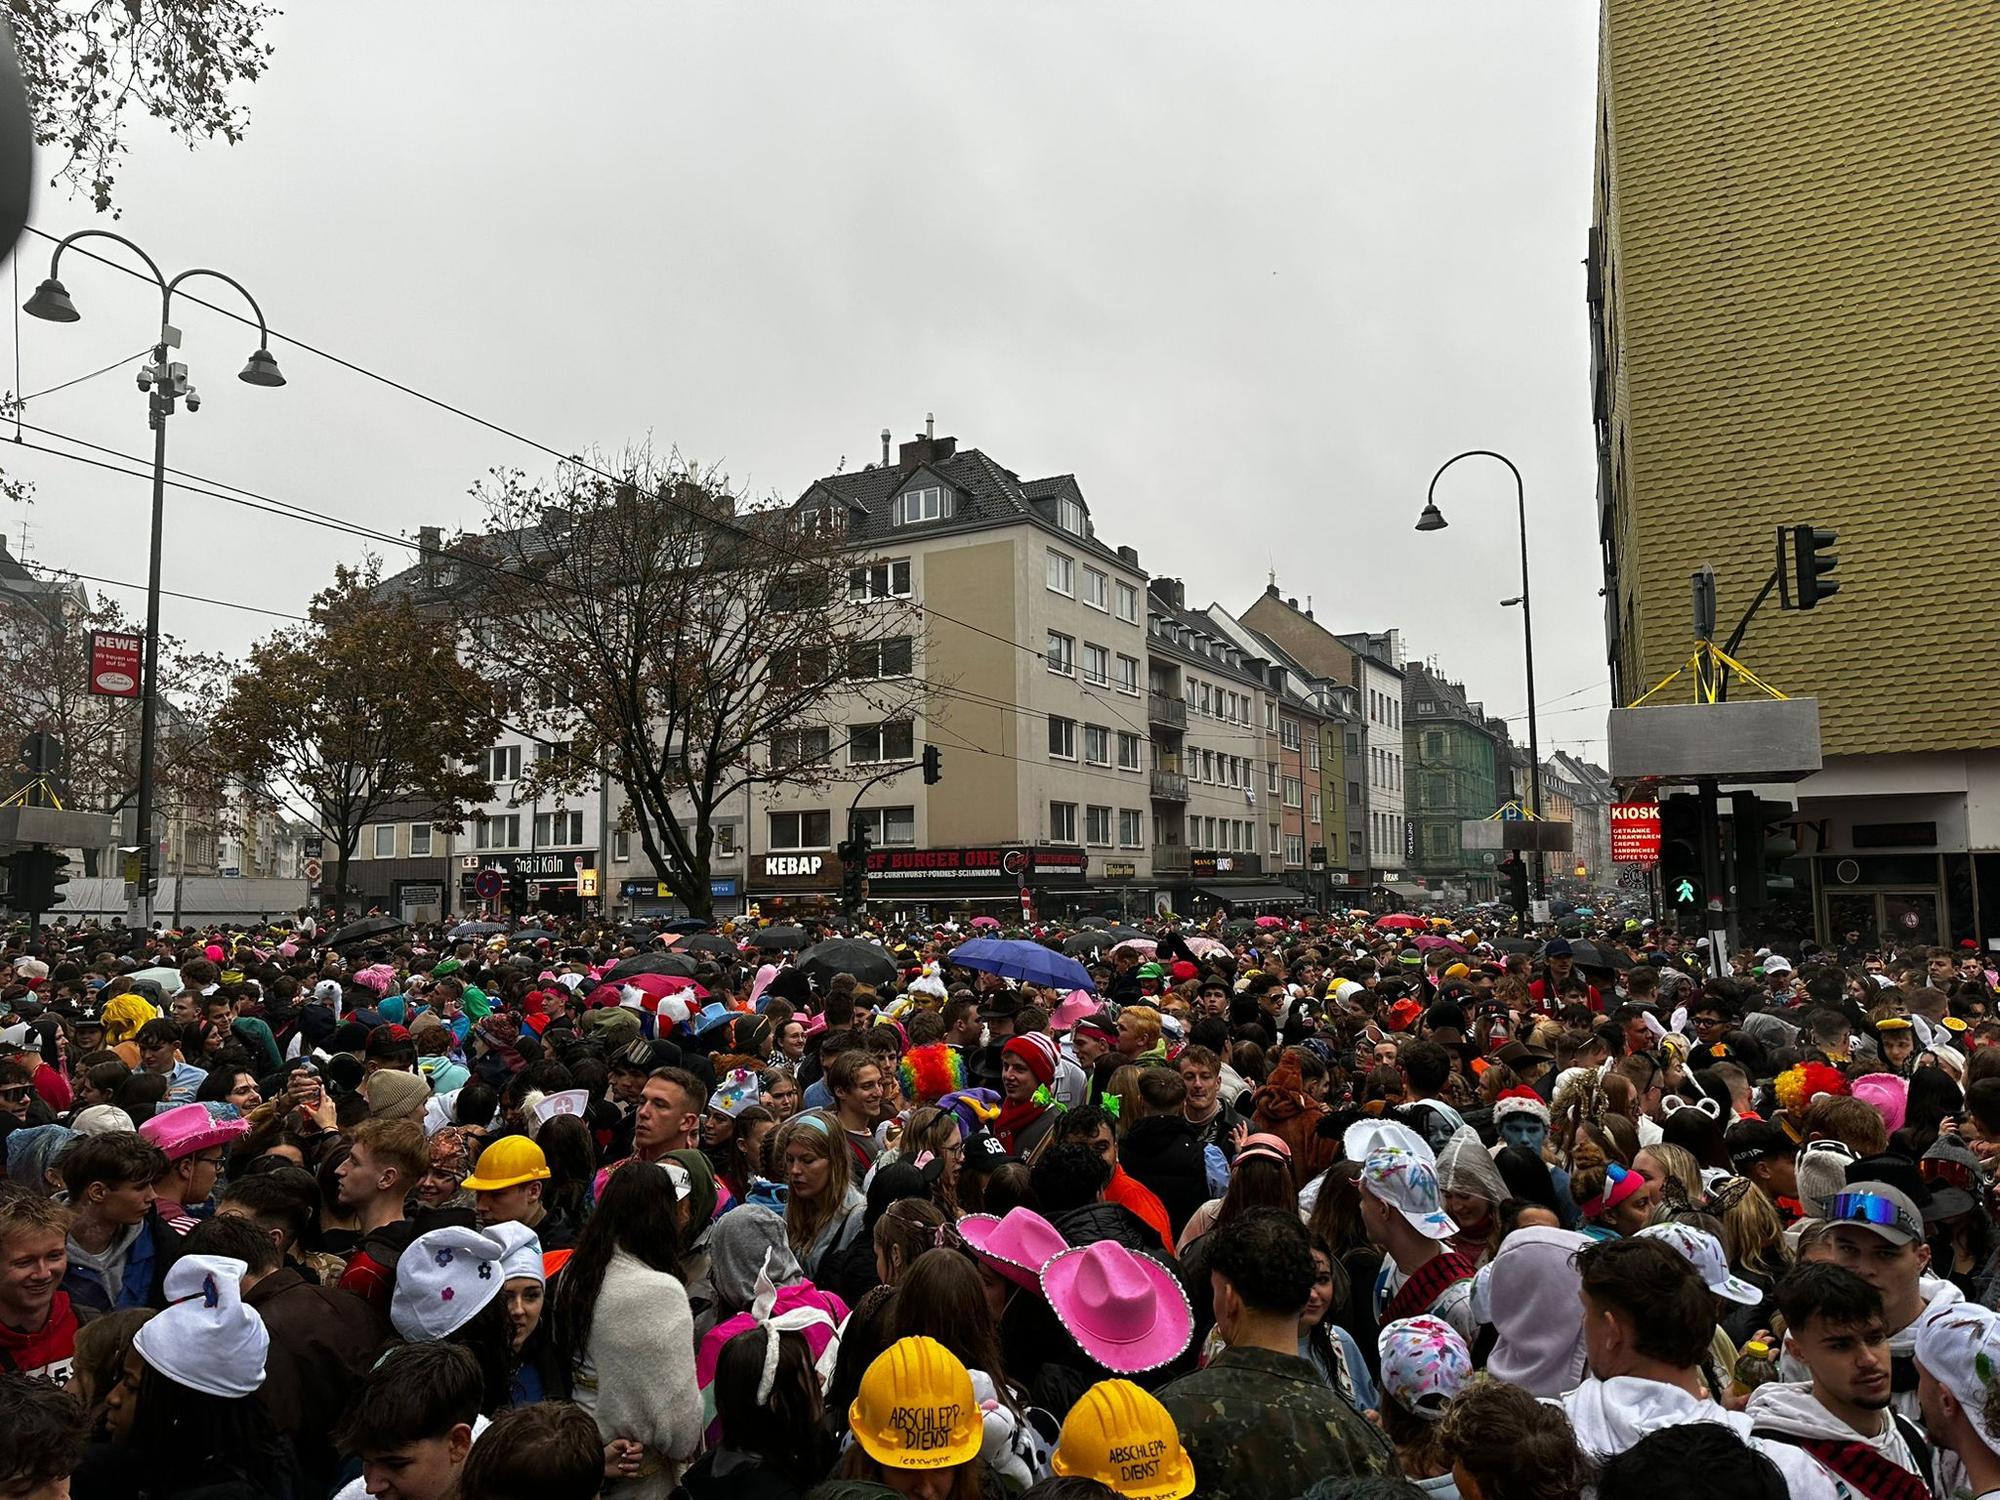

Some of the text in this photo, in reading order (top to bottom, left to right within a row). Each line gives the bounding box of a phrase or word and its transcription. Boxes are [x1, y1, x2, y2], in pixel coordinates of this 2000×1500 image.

[95, 635, 138, 651] REWE
[1611, 807, 1661, 820] KIOSK
[541, 855, 563, 873] Köln
[765, 856, 822, 875] KEBAP
[892, 851, 961, 868] BURGER
[965, 850, 1001, 866] ONE
[905, 1426, 952, 1450] DIENST
[1121, 1459, 1160, 1482] DIENST
